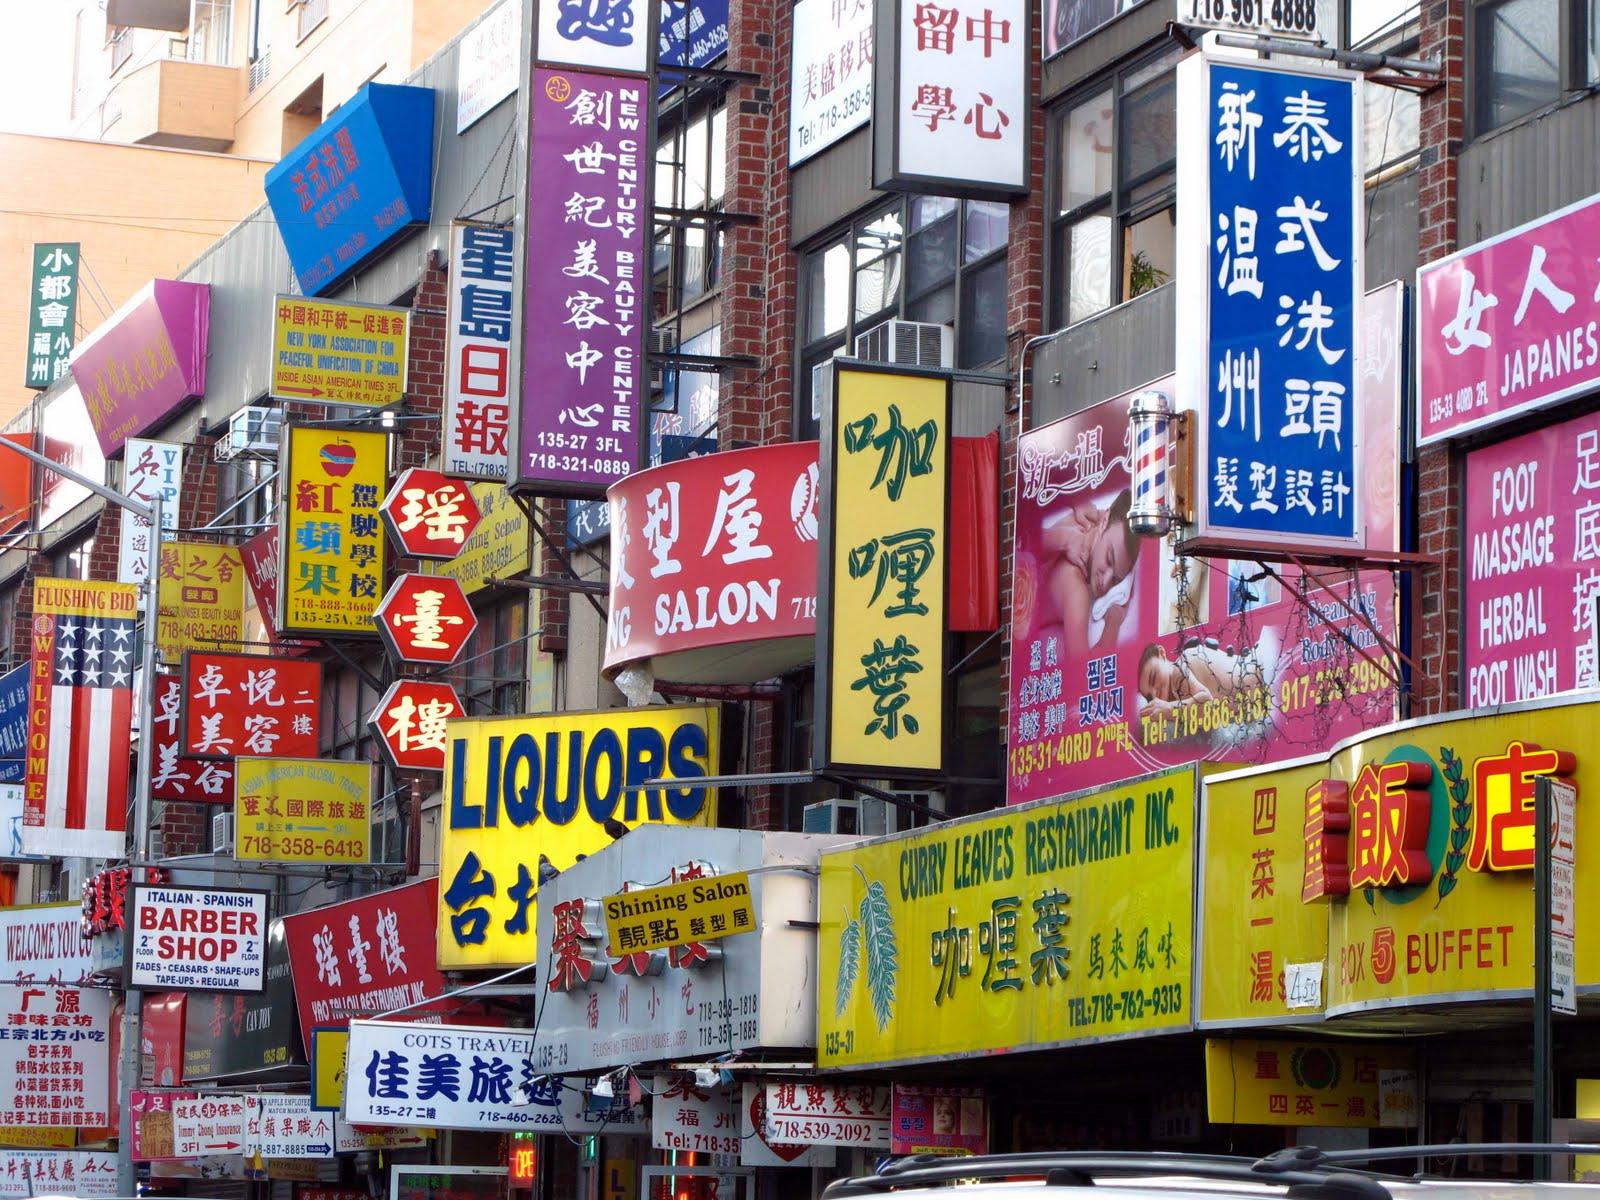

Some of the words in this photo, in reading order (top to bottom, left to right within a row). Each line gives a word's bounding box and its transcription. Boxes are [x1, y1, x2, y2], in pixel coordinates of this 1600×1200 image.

[618, 89, 639, 130] NEW
[615, 140, 638, 238] CENTURY
[559, 89, 616, 427] 創世紀美容中心
[1273, 90, 1345, 452] 泰式洗頭
[38, 248, 74, 327] 小都會
[614, 251, 635, 337] BEAUTY
[279, 305, 404, 335] 中國和平統一促進會
[32, 332, 50, 381] 福州
[287, 331, 304, 346] NEW
[308, 333, 326, 349] YORK
[330, 336, 377, 355] ASSOCIATION
[381, 342, 394, 356] FOR
[279, 351, 314, 369] PEACEFUL
[317, 355, 362, 373] UNIFICATION
[366, 360, 374, 374] OF
[377, 361, 399, 376] CHINA
[277, 372, 299, 382] INSIDE
[302, 373, 322, 385] ASIAN
[327, 376, 361, 388] AMERICAN
[364, 379, 385, 391] TIMES
[612, 347, 633, 432] CENTER
[1430, 395, 1453, 423] 135-33
[538, 433, 587, 450] 135-27
[595, 436, 622, 452] 3FL
[162, 450, 178, 502] VIP
[529, 454, 631, 475] 718-321-0889
[1214, 457, 1351, 519] 髮型設計
[1492, 461, 1538, 518] FOOT
[295, 480, 342, 596] 紅蘋果
[349, 483, 379, 598] 駕駛學校
[495, 512, 521, 540] School
[1472, 516, 1554, 581] MASSAGE
[36, 587, 105, 608] FLUSHING
[111, 590, 135, 611] BID
[293, 599, 374, 612] 718-888-3668
[655, 578, 781, 637] SALON
[161, 621, 238, 641] 718-463-5496
[1479, 586, 1547, 649] HERBAL
[1469, 660, 1508, 709] FOOT
[1513, 648, 1557, 703] WASH
[27, 636, 53, 800] WELCOME
[1142, 713, 1167, 746] Tel:
[193, 712, 280, 756] 美容
[1010, 733, 1052, 777] 135-31
[1056, 730, 1091, 766] 40RD
[450, 723, 708, 830] LIQUORS
[243, 836, 363, 858] 718-358-6413
[899, 842, 947, 902] CURRY
[953, 825, 1014, 890] LEAVES
[1025, 796, 1134, 876] RESTAURANT
[1144, 786, 1179, 850] INC.
[148, 891, 193, 905] ITALIAN
[203, 894, 254, 908] SPANISH
[607, 893, 688, 921] Shining
[693, 882, 748, 904] Salon
[1250, 786, 1277, 1003] 四菜一湯
[140, 906, 258, 936] BARBER
[689, 908, 749, 937] 髮型屋
[6, 921, 55, 962] WELCOME
[57, 920, 78, 959] YOU
[136, 948, 154, 957] FLOOR
[241, 952, 260, 961] FLOOR
[157, 935, 238, 962] SHOP
[1087, 921, 1177, 980] 馬來風味
[1371, 925, 1396, 985] 5
[1407, 925, 1514, 975] BUFFET
[136, 962, 161, 972] FADES
[167, 965, 208, 975] CEASARS
[215, 966, 260, 977] SHAPE-UPS
[155, 974, 195, 986] TAPE-UPS
[201, 977, 239, 988] REGULAR
[21, 988, 81, 1013] 广源
[359, 984, 411, 1011] RESTAURANT
[588, 978, 695, 1031] 福州小吃
[8, 1013, 93, 1026] 津味食坊
[28, 1044, 73, 1059] 包子系列
[403, 1033, 452, 1049] COTS
[538, 1042, 568, 1068] 135-29
[825, 1030, 854, 1056] 135-31
[369, 1105, 414, 1118] 135-27
[478, 1110, 563, 1125] 718-460-2628
[665, 1132, 690, 1149] Tel:
[774, 1120, 872, 1142] 718-539-2092
